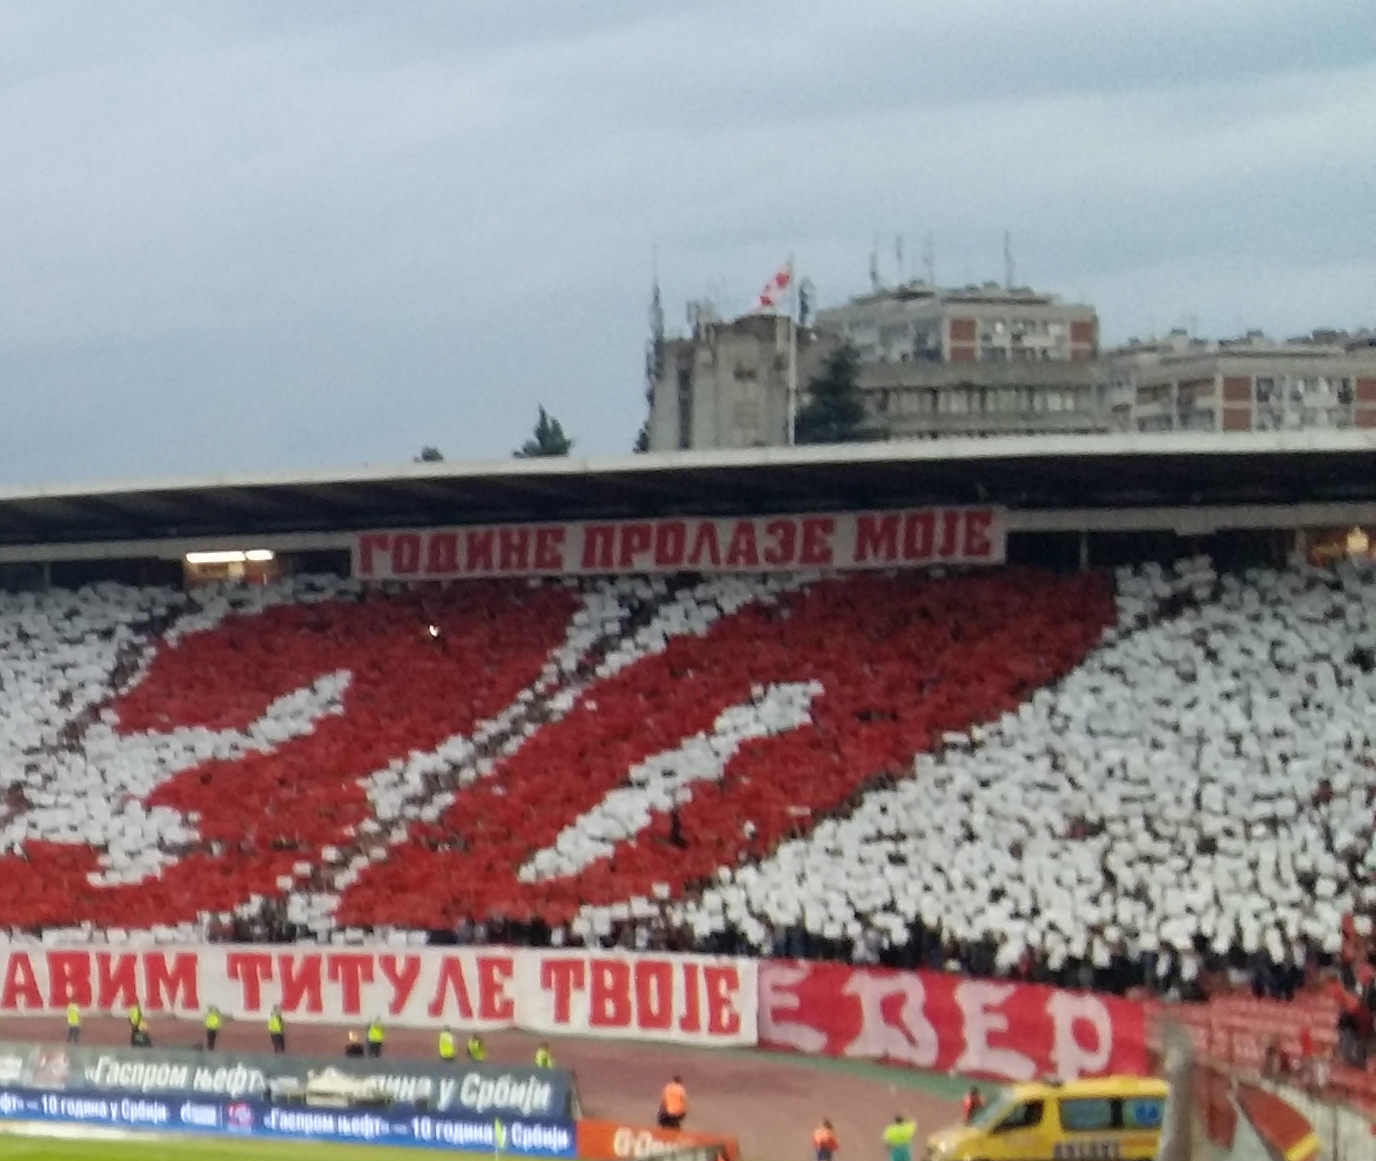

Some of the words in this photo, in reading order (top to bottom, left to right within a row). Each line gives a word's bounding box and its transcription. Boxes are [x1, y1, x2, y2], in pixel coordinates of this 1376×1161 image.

[358, 527, 566, 576] ГОДИНЕ
[580, 517, 834, 569] ПРОЛАЗЕ
[853, 507, 994, 561] МОЈЕ
[225, 951, 515, 1020] ТИТУЛЕ
[539, 957, 741, 1035] ТВОЈЕ
